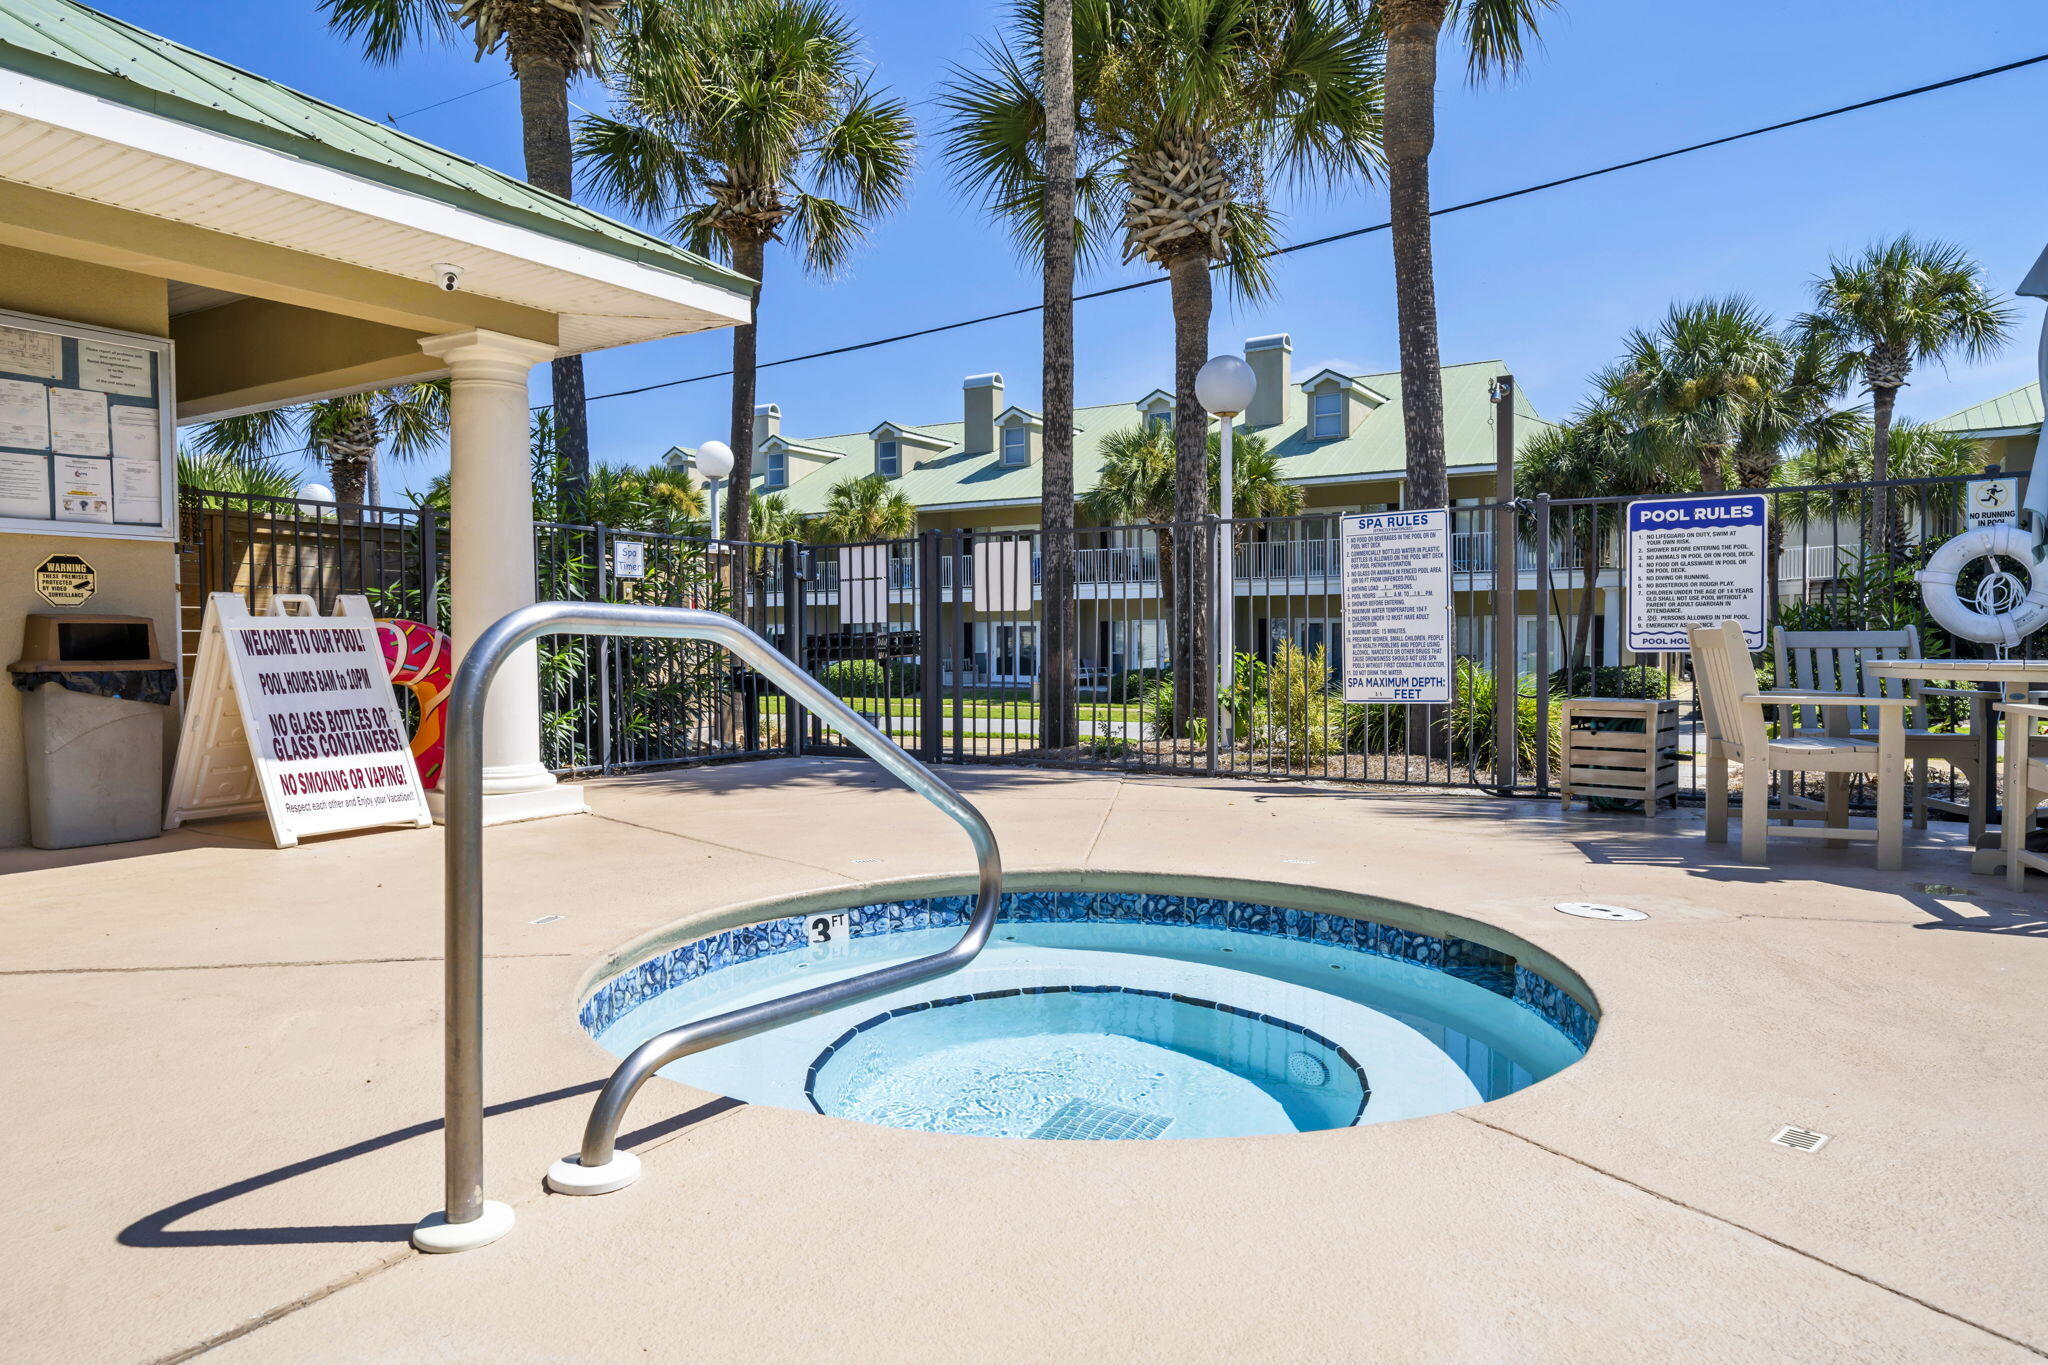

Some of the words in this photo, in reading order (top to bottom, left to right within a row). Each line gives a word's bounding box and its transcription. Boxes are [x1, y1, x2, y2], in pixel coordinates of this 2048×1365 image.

[1359, 518, 1382, 529] SPA
[1388, 515, 1428, 527] RULES
[1641, 509, 1689, 522] POOL
[1694, 505, 1753, 520] RULES
[622, 548, 636, 558] Spa
[47, 563, 86, 572] WARNING
[619, 561, 641, 571] Timer
[240, 629, 297, 656] WELCOME
[296, 629, 310, 654] TO
[310, 629, 334, 653] OUR
[333, 629, 366, 652] POOL!
[259, 673, 286, 695] POOL
[284, 670, 317, 693] HOURS
[317, 669, 338, 691] 8AM
[336, 670, 347, 690] to
[347, 668, 371, 689] 10PM
[1348, 678, 1364, 687] SPA
[1366, 678, 1409, 687] MAXIMUM
[1412, 677, 1445, 687] DEPTH:
[1394, 689, 1422, 699] FEET
[269, 714, 287, 736] NO
[289, 711, 326, 734] GLASS
[326, 709, 372, 732] BOTTLES
[372, 708, 389, 728] OR
[273, 735, 318, 762] GLASS
[319, 728, 402, 758] CONTAINERS!
[280, 773, 298, 796] NO
[298, 769, 349, 794] SMOKING
[350, 767, 366, 789] OR
[366, 765, 407, 788] VAPING!
[286, 802, 311, 814] Respect
[312, 800, 326, 810] each
[328, 798, 344, 809] other
[346, 796, 357, 807] and
[358, 794, 373, 806] Enjoy
[374, 794, 386, 806] your
[812, 918, 831, 943] 3
[832, 914, 844, 927] FT
